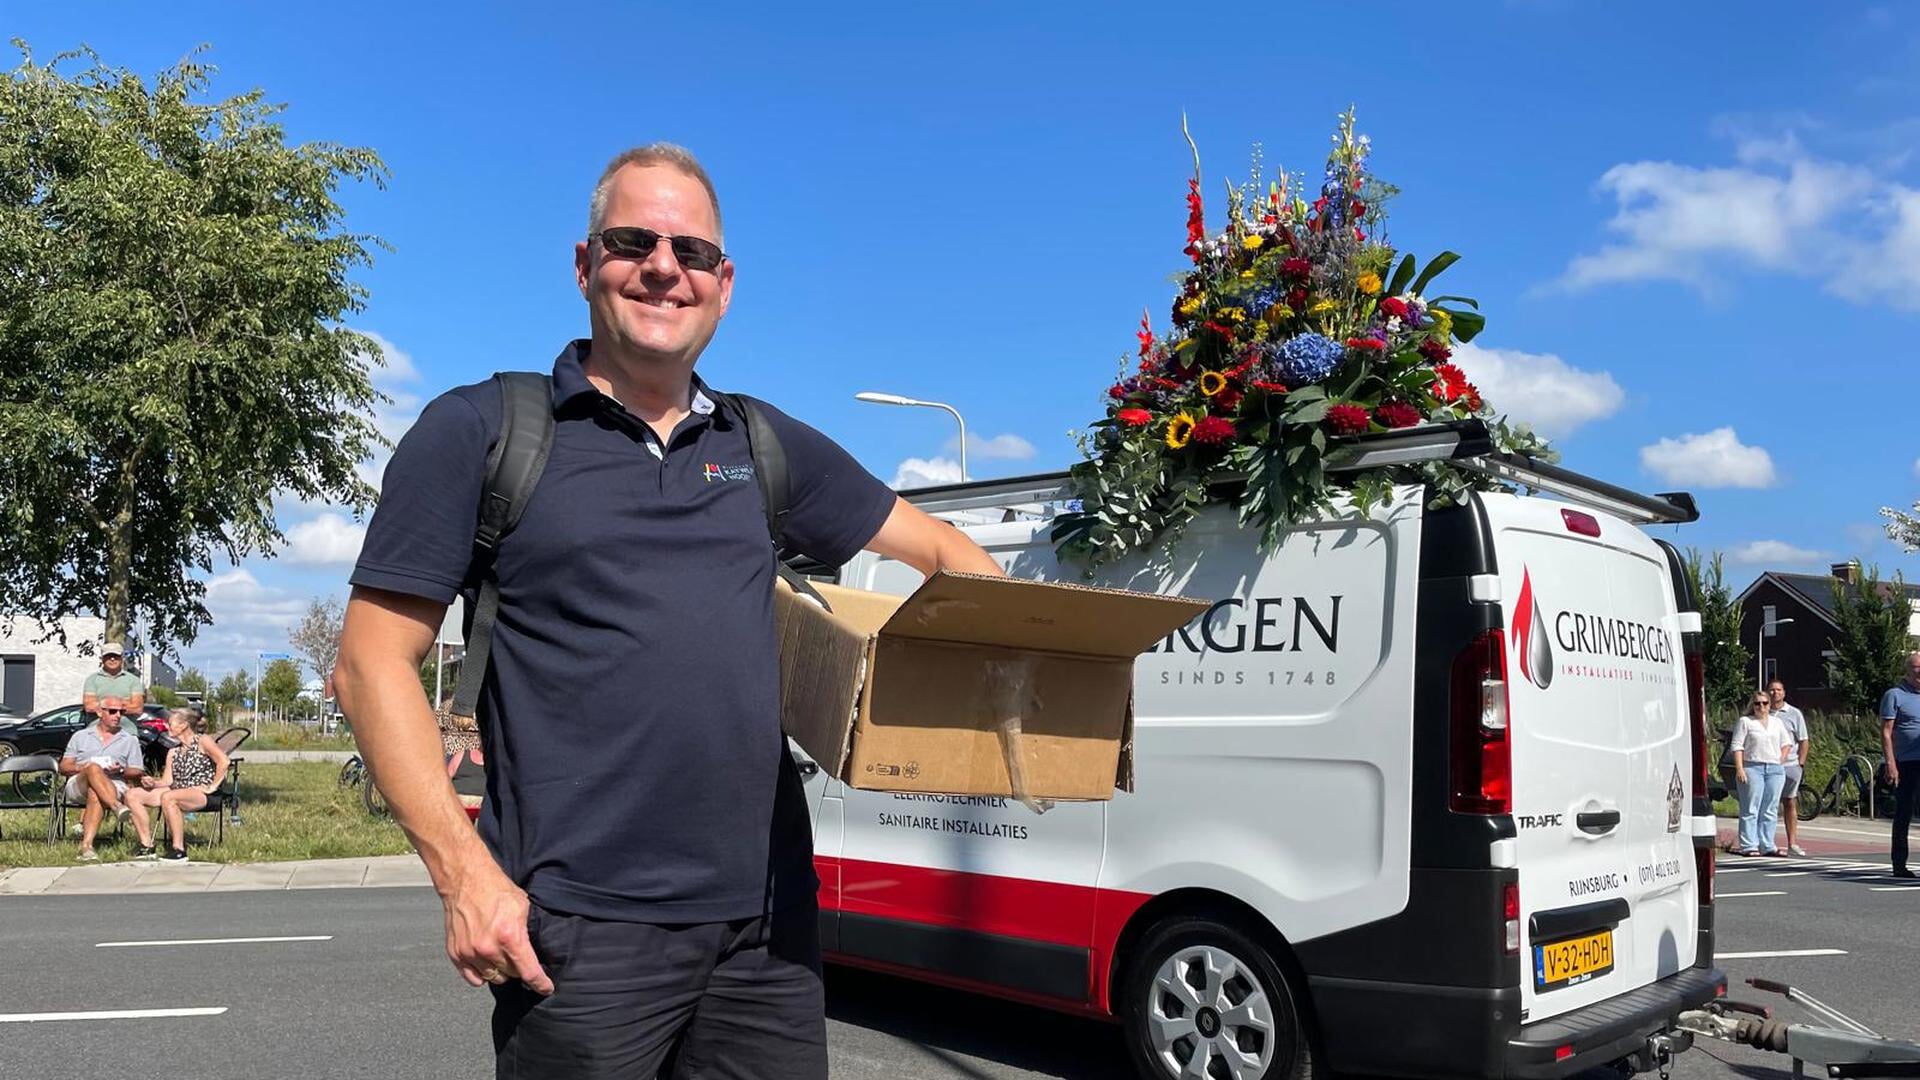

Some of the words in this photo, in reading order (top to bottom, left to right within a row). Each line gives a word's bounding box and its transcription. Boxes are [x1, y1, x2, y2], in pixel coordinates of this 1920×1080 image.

[1145, 595, 1344, 654] RGEN
[1555, 611, 1674, 664] GRIMBERGEN
[1161, 671, 1245, 685] SINDS
[1268, 671, 1336, 685] 1748
[1561, 664, 1633, 680] INSTALLATIES
[879, 813, 939, 830] SANITAIRE
[942, 819, 1028, 839] INSTALLATIES
[1518, 813, 1562, 829] TRAFIC
[1569, 873, 1619, 897] RIJNSBURG
[1548, 936, 1609, 977] V-32-HDH
